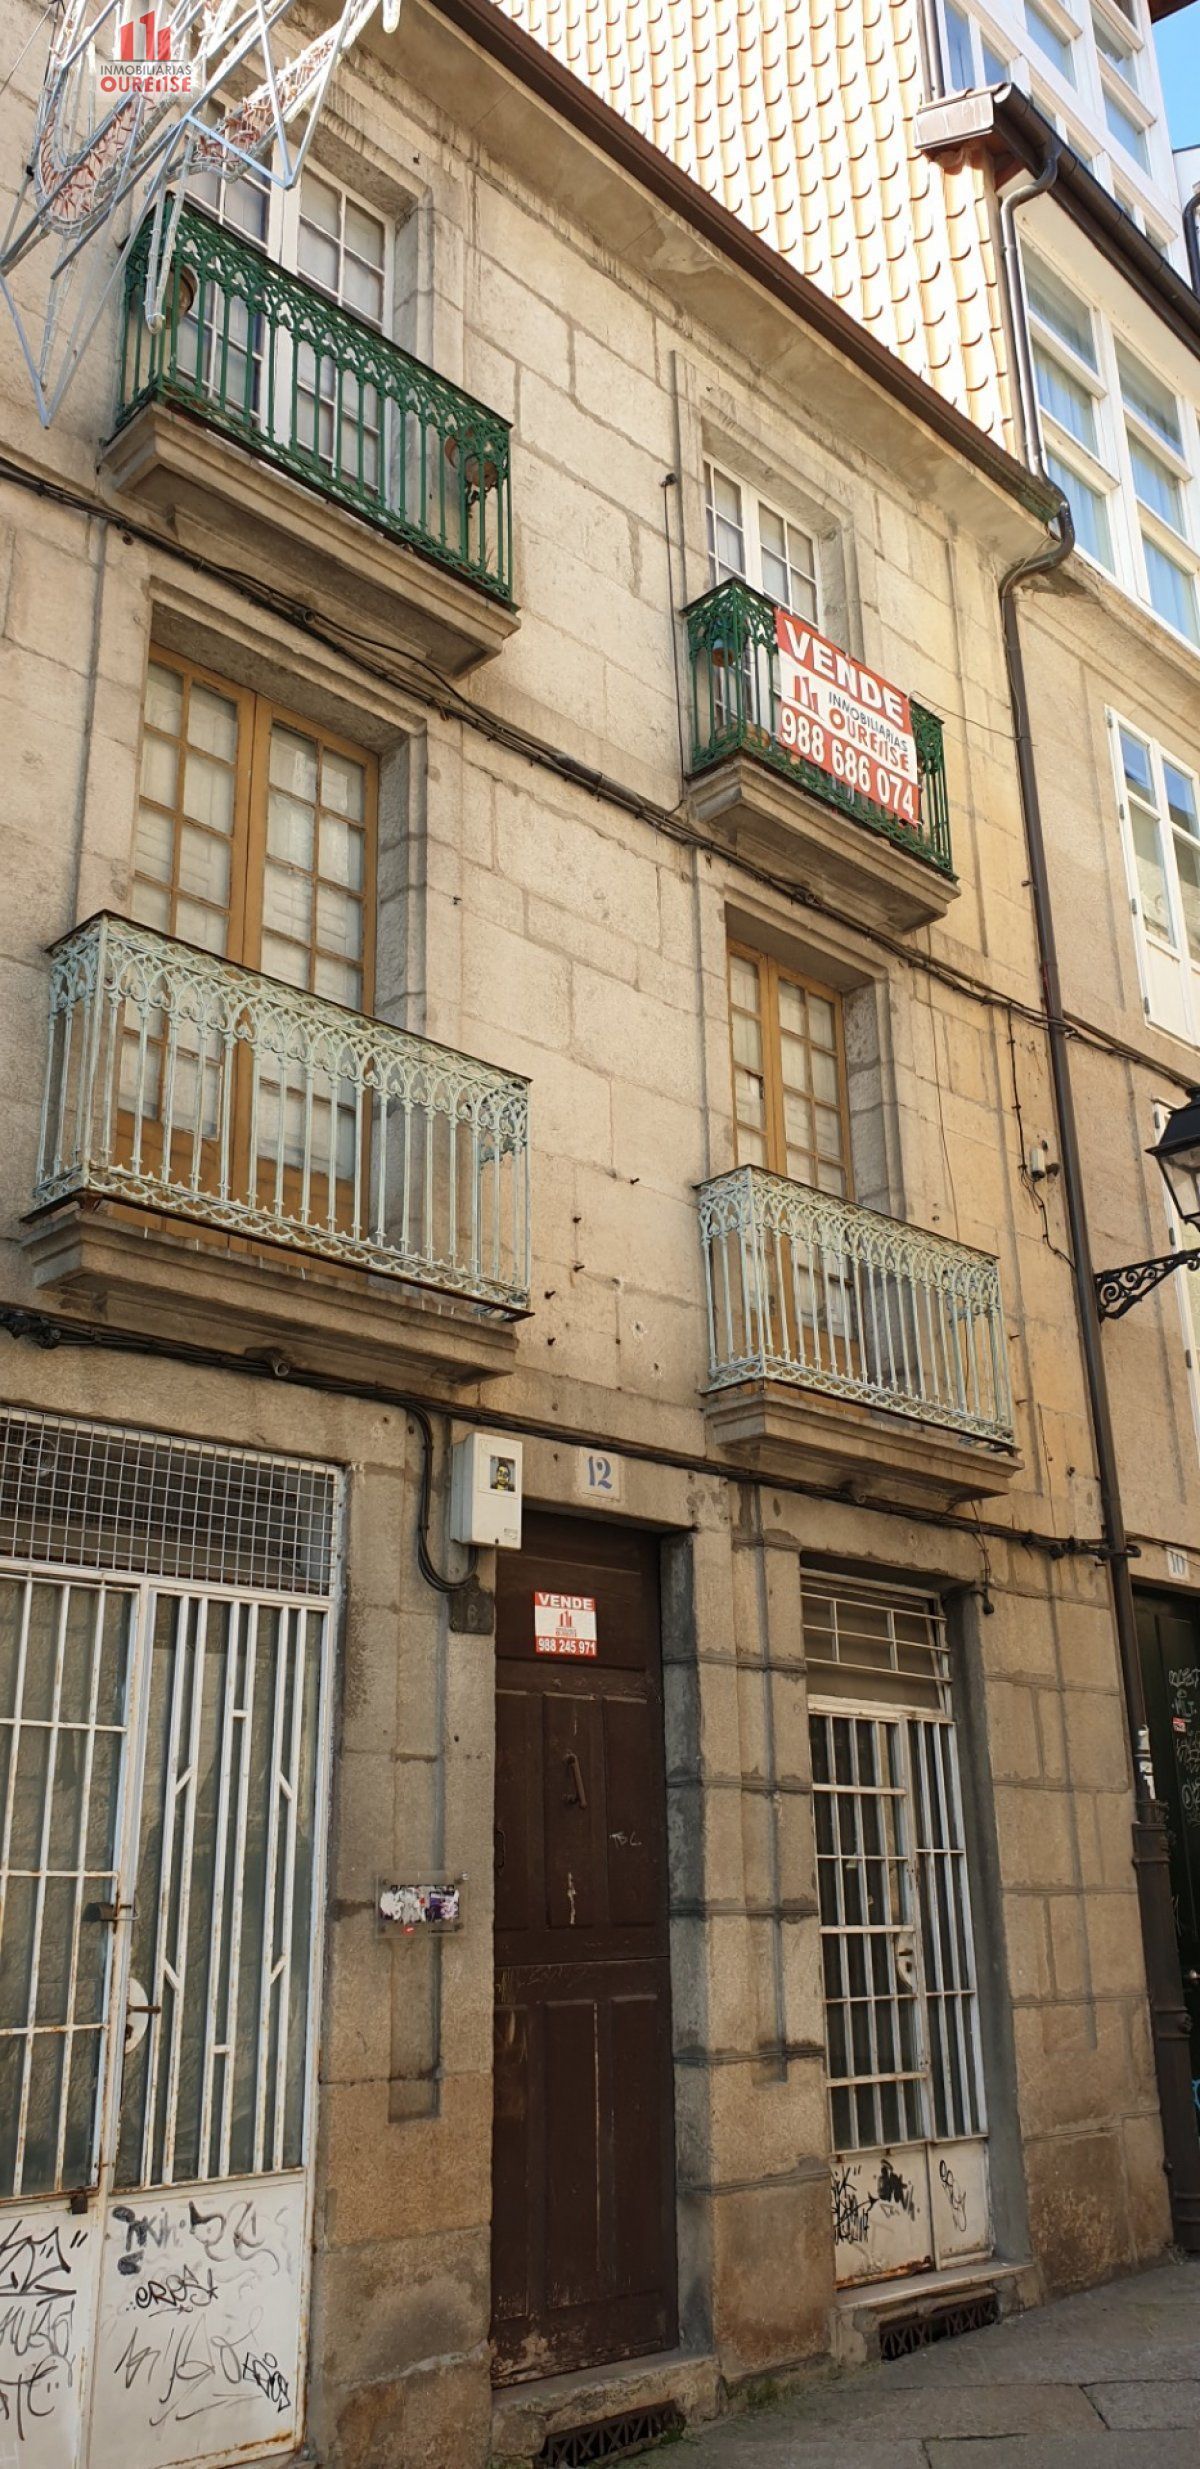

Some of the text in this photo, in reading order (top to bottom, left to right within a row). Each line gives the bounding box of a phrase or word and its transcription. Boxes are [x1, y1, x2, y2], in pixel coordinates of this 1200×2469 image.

[784, 619, 904, 728] VENDE
[829, 691, 908, 752] INMOBILIARIAS
[829, 708, 909, 772] OURENSE
[781, 707, 914, 820] 988 686 074
[588, 1455, 612, 1489] 12
[1171, 1551, 1185, 1574] 10
[538, 1593, 592, 1610] VENDE
[538, 1638, 597, 1656] 988 245 971
